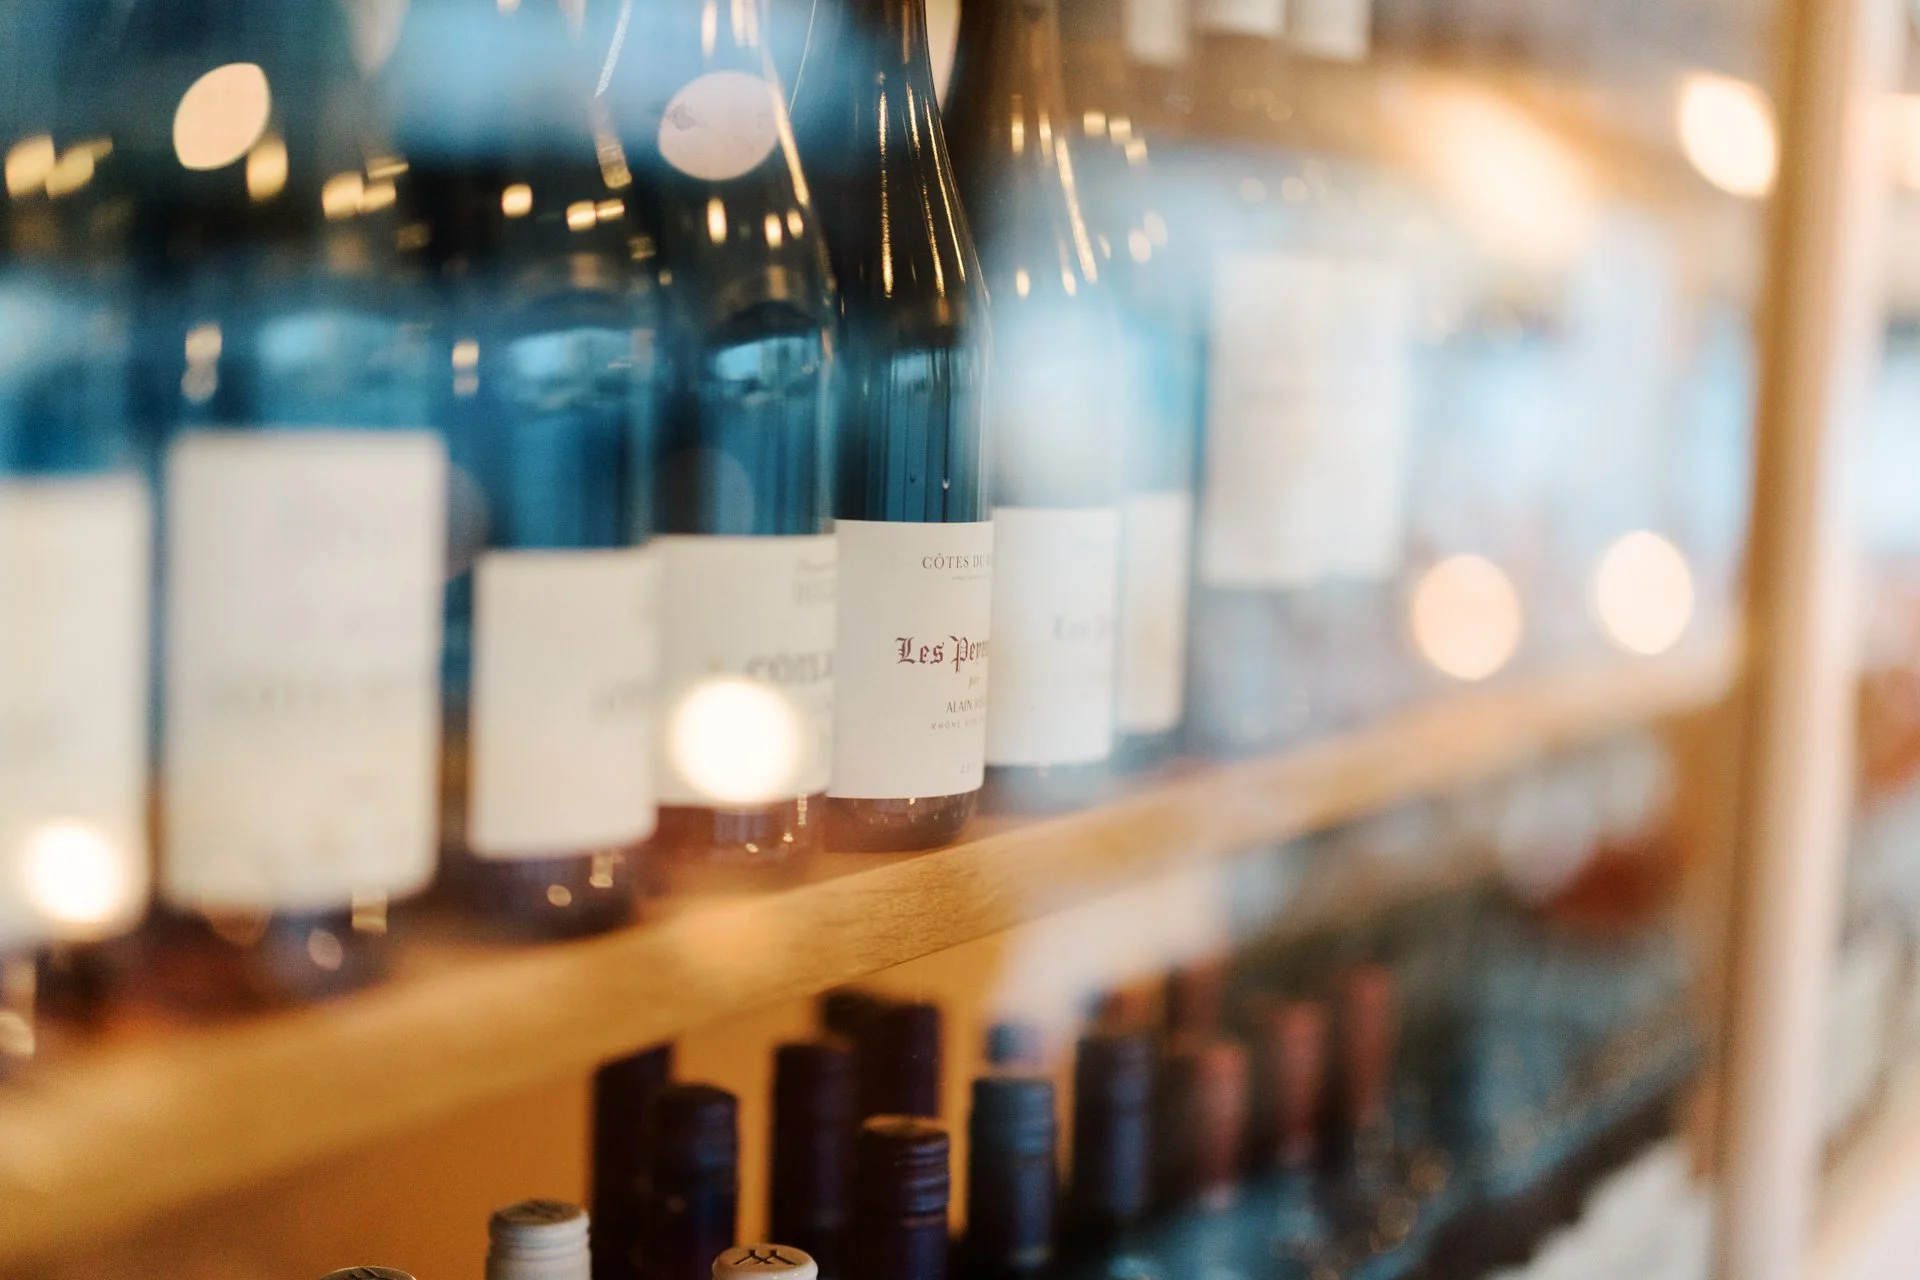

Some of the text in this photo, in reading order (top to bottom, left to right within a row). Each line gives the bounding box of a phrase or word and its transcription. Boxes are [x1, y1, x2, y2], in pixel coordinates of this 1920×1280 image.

[922, 552, 969, 570] CÔTES
[895, 637, 945, 665] Les
[945, 698, 973, 714] ALAIN
